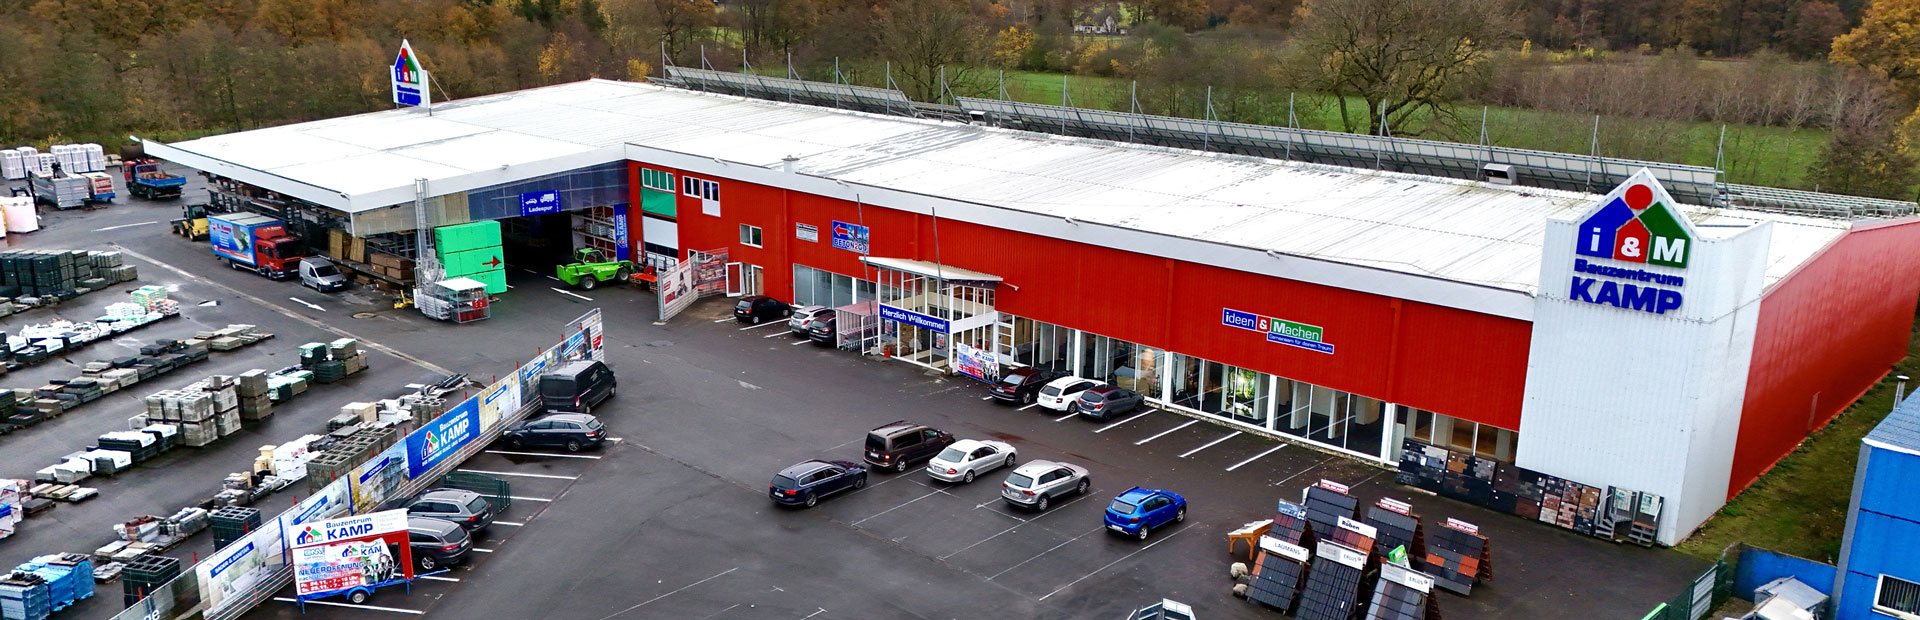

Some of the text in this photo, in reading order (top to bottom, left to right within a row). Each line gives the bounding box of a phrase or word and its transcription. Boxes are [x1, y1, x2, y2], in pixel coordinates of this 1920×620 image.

[1590, 227, 1600, 252] i
[1653, 236, 1686, 263] M
[1574, 258, 1684, 287] Bauzentrum
[1570, 276, 1682, 314] KAMP
[882, 308, 906, 321] Herzlich
[1226, 312, 1254, 327] ideen
[1273, 321, 1319, 341] Machen
[440, 411, 468, 431] Bauzentrum
[440, 418, 469, 447] KAMP
[326, 517, 372, 529] Bauzentrum
[327, 524, 373, 540] KAMP
